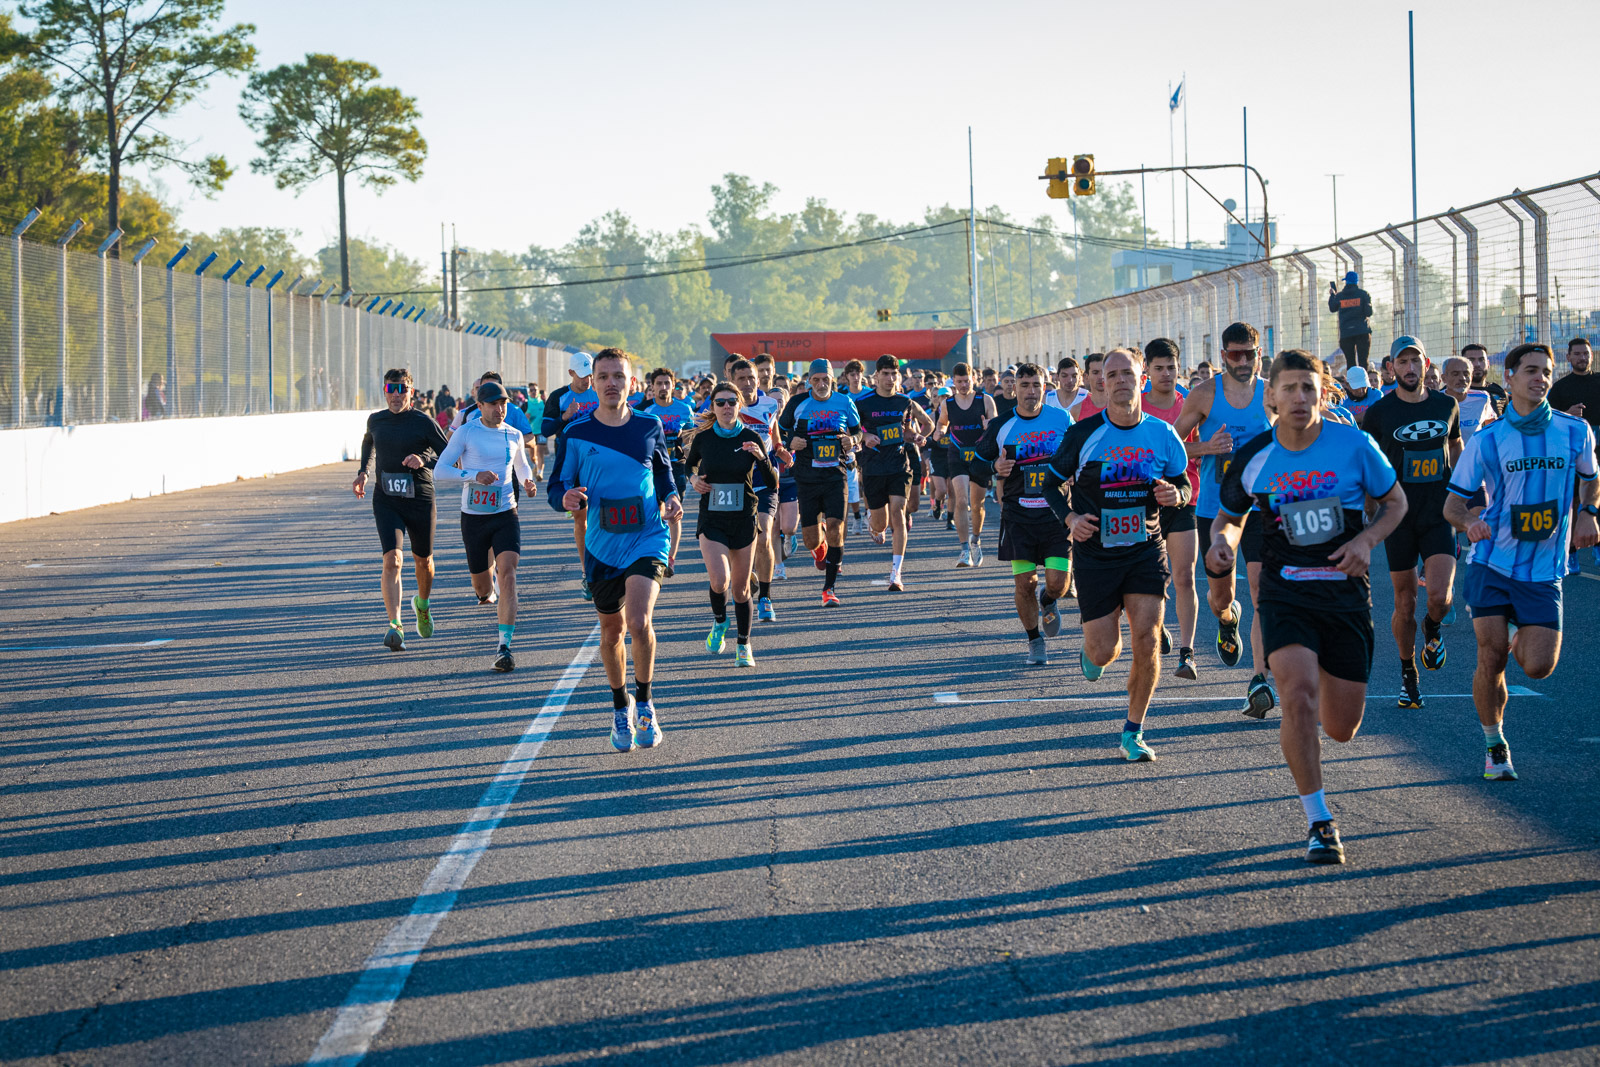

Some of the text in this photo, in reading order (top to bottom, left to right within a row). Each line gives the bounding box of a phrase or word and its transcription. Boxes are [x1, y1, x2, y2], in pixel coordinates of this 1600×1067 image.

[882, 427, 900, 440] 702
[818, 445, 835, 458] 797
[1100, 462, 1149, 482] RUN
[1412, 458, 1438, 477] 760
[1506, 457, 1565, 473] GUEPARD
[388, 479, 408, 493] 167
[473, 490, 496, 506] 374
[718, 490, 733, 505] 21
[609, 505, 638, 525] 312
[1293, 508, 1333, 536] 105
[1520, 509, 1553, 532] 705
[1110, 514, 1140, 535] 359
